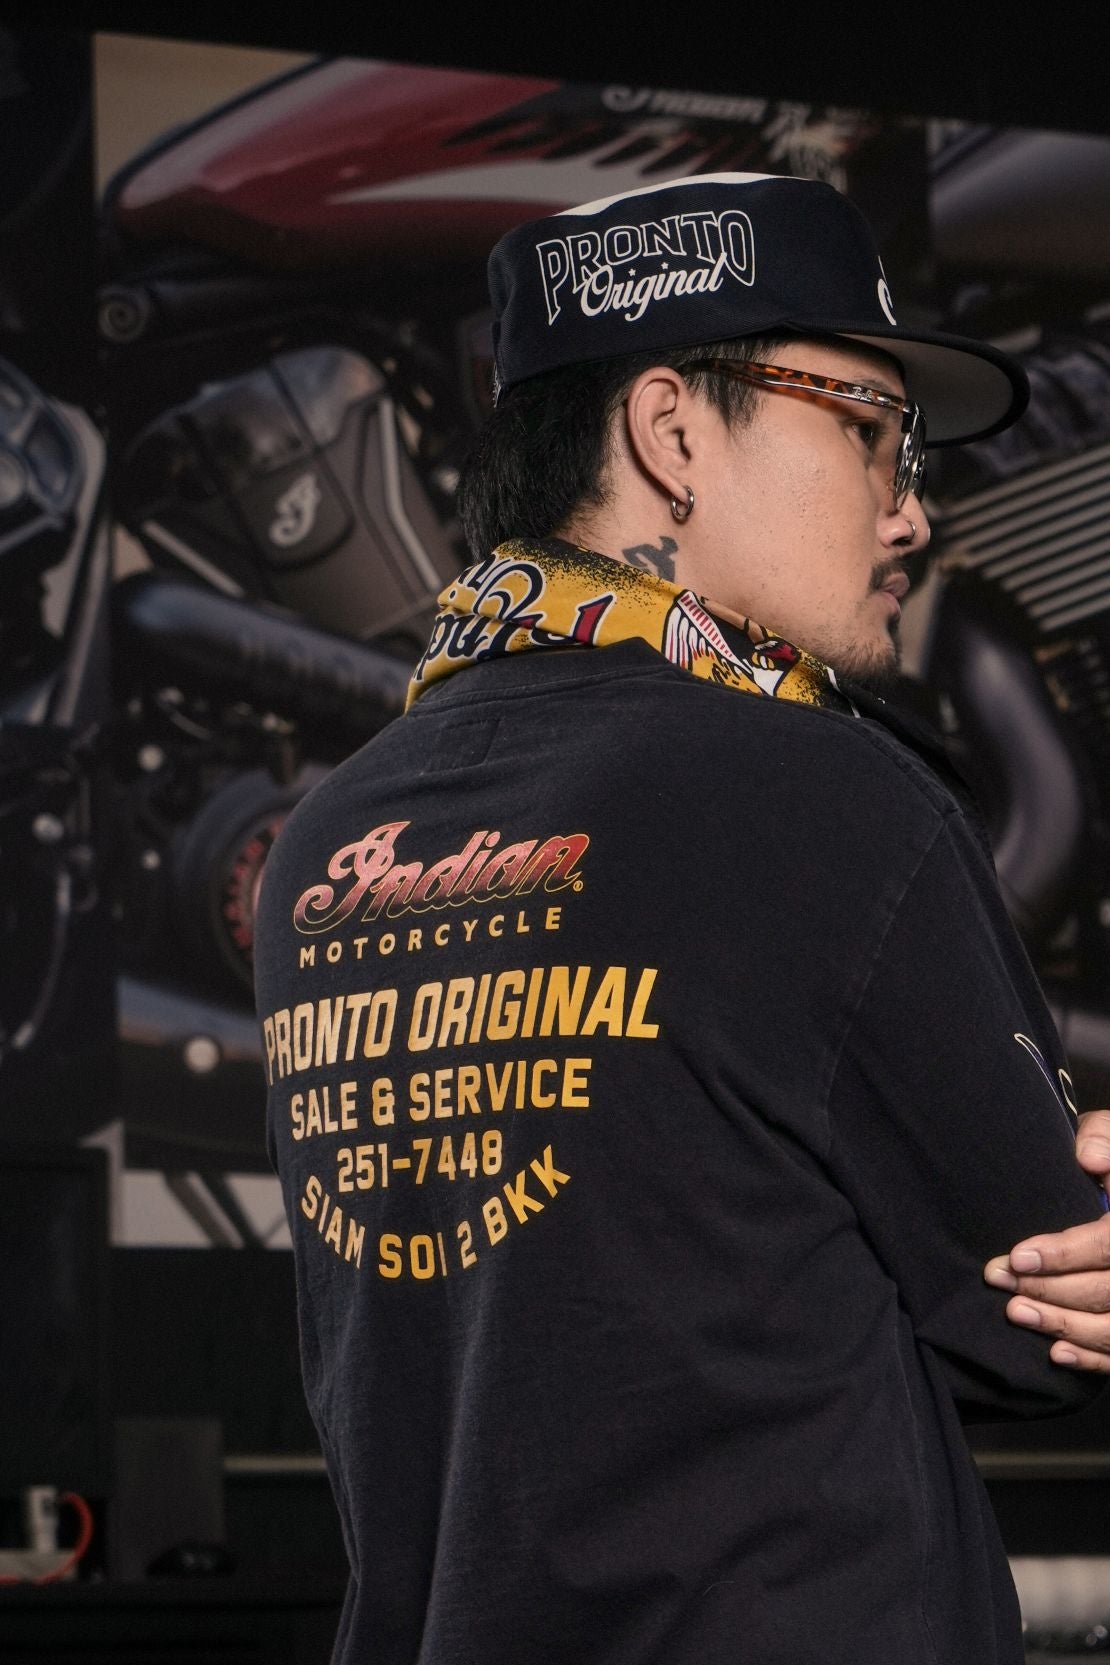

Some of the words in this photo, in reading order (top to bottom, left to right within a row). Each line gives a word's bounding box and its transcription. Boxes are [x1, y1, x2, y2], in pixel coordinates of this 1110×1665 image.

[536, 210, 755, 326] PRONTO
[580, 252, 728, 322] Original
[293, 820, 590, 936] Indian
[299, 906, 563, 969] MOTORCYCLE
[263, 988, 398, 1086] PRONTO
[407, 965, 660, 1053] ORIGINAL
[291, 1081, 358, 1141] SALE
[371, 1077, 395, 1127] &
[409, 1057, 592, 1122] SERVICE
[337, 1129, 503, 1193] 251-7448
[301, 1175, 366, 1269] SIAM
[378, 1232, 448, 1280] SOI
[457, 1220, 478, 1269] 2
[482, 1143, 572, 1247] BKK
